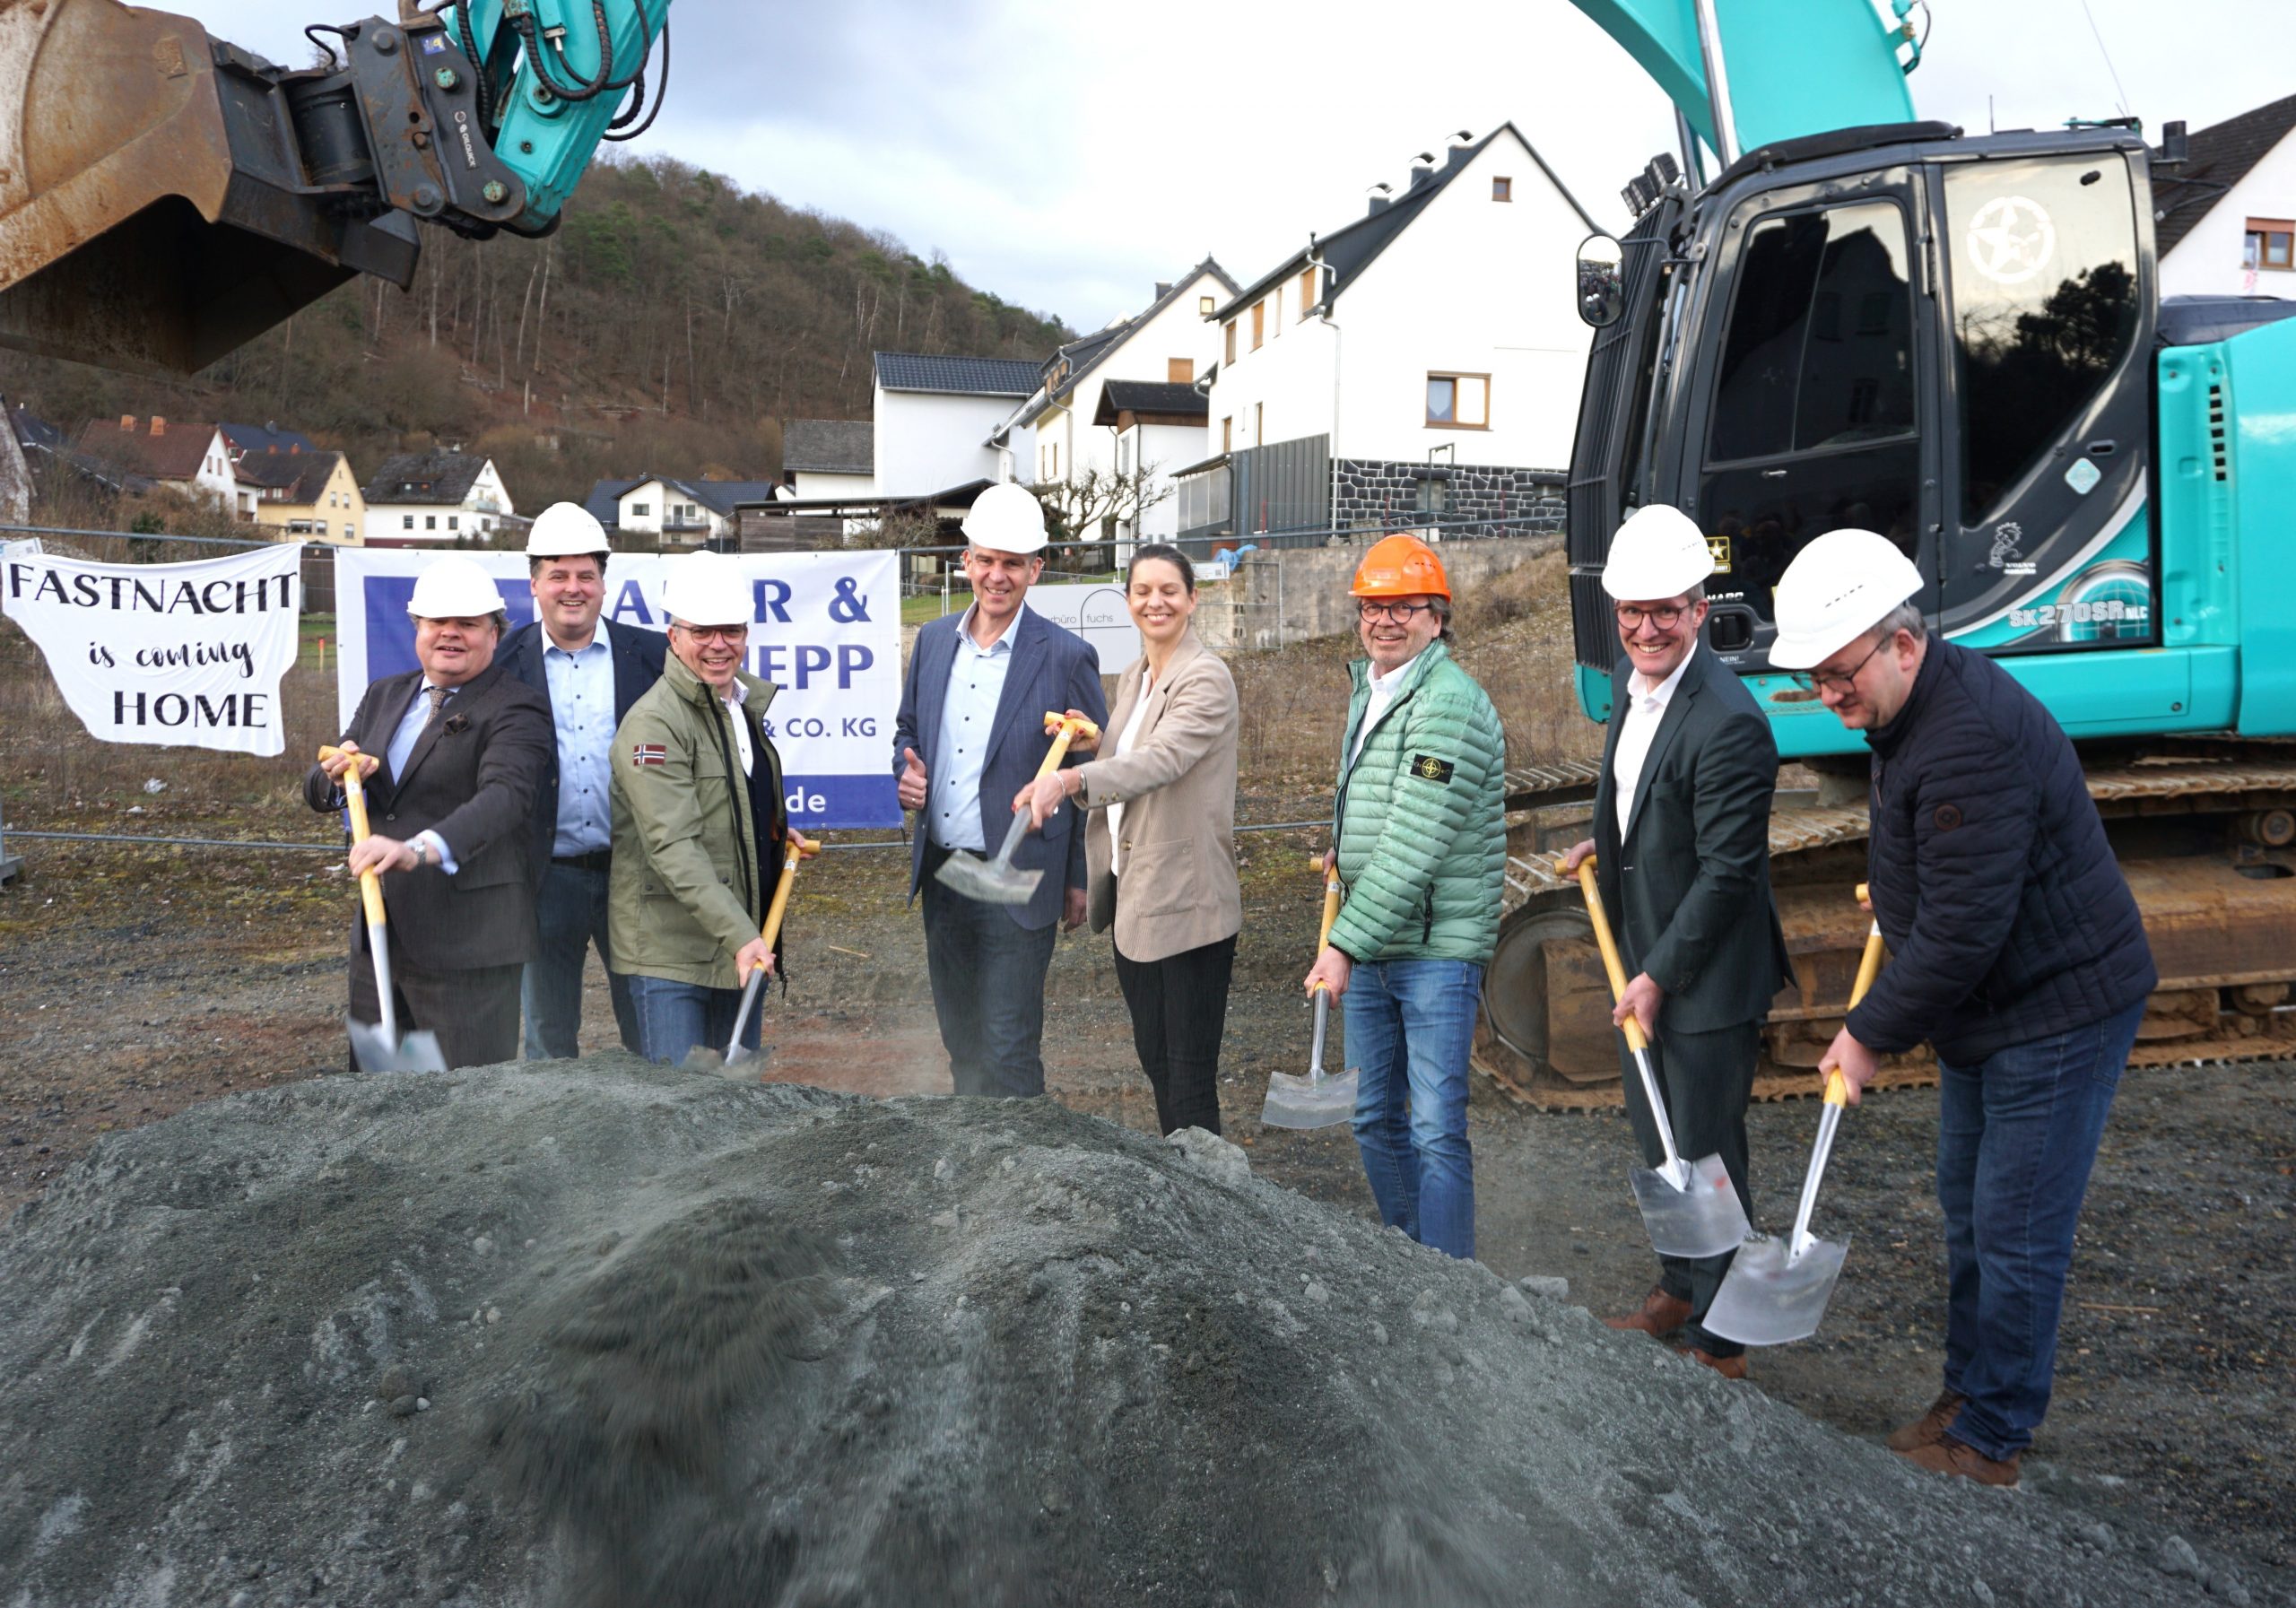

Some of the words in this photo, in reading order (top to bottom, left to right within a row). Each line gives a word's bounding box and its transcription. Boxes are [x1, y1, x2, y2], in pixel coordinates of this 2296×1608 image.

[9, 562, 299, 614] FASTNACHT
[827, 576, 872, 623] &
[1087, 613, 1114, 623] fuchs
[90, 641, 116, 668] is
[135, 641, 254, 679] coming
[114, 691, 268, 728] HOME
[786, 717, 831, 738] CO.
[842, 717, 876, 738] KG
